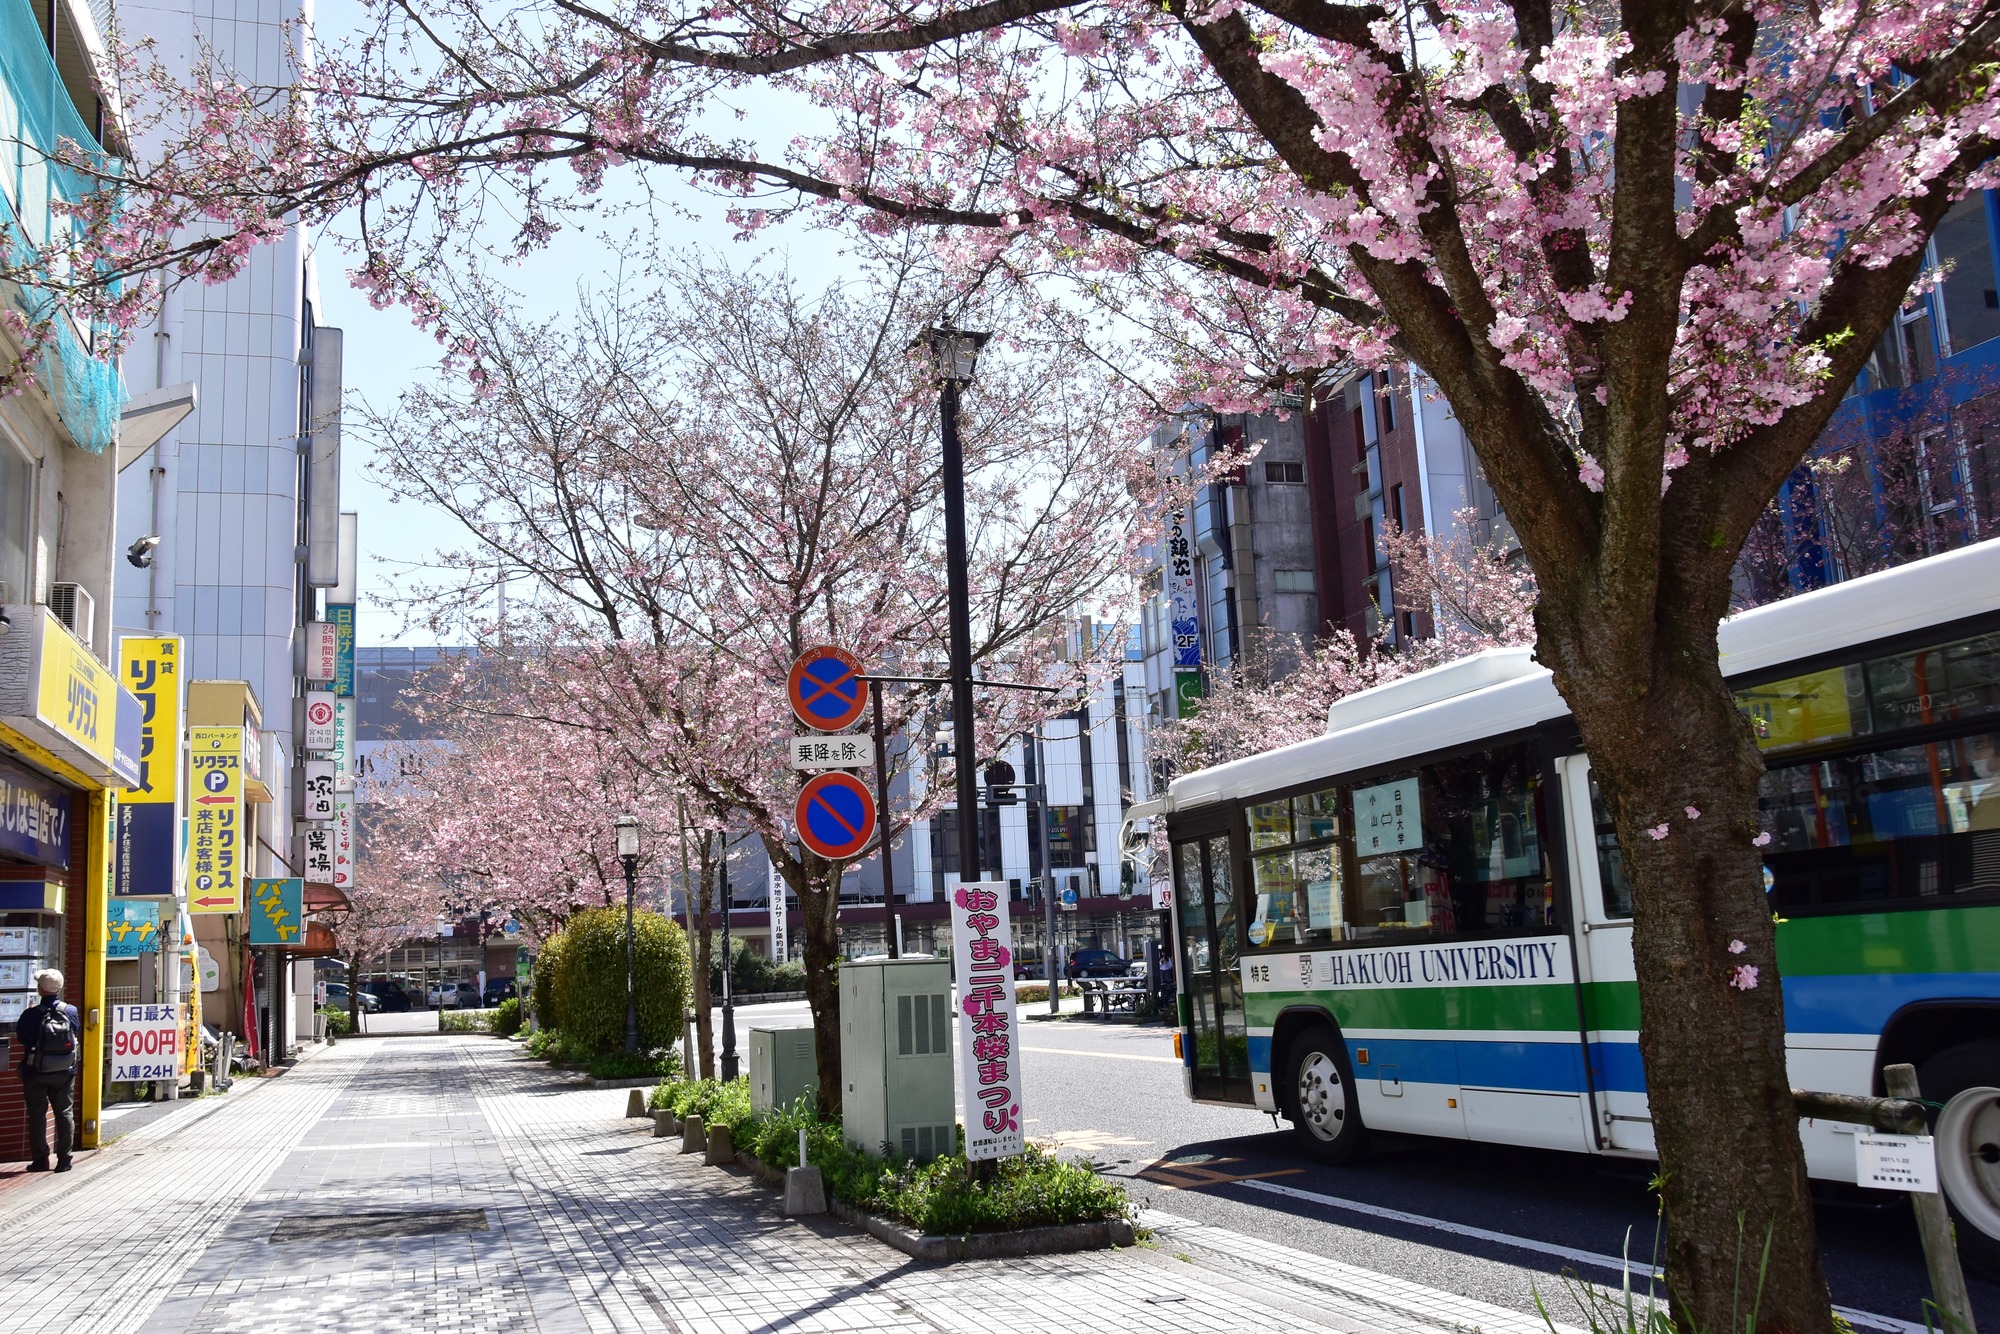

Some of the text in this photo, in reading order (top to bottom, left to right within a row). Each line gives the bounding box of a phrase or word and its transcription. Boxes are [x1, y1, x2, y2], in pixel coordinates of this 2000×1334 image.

[337, 608, 353, 653] 日焼け
[1177, 635, 1195, 648] 2F
[160, 642, 174, 674] 賃貸
[322, 625, 334, 678] 24時間営業
[67, 673, 99, 743] リクラス
[127, 660, 157, 793] リクラス
[195, 731, 239, 740] 西口パーキング
[798, 742, 867, 762] 乗降を除く
[193, 756, 239, 768] リクラス
[307, 776, 333, 812] 塚田
[196, 809, 213, 873] 来店お客様
[218, 809, 234, 889] リクラス
[308, 831, 331, 872] 農場
[255, 879, 299, 941] バナナヤ
[1250, 965, 1270, 983] 特定
[1331, 952, 1413, 985] HAKUOH
[1419, 942, 1557, 983] UNIVERSITY
[117, 1005, 174, 1022] 1日最大
[966, 888, 1011, 1134] おやま二千本桜まつり
[115, 1029, 176, 1056] 900円
[116, 1065, 173, 1080] 入庫24H
